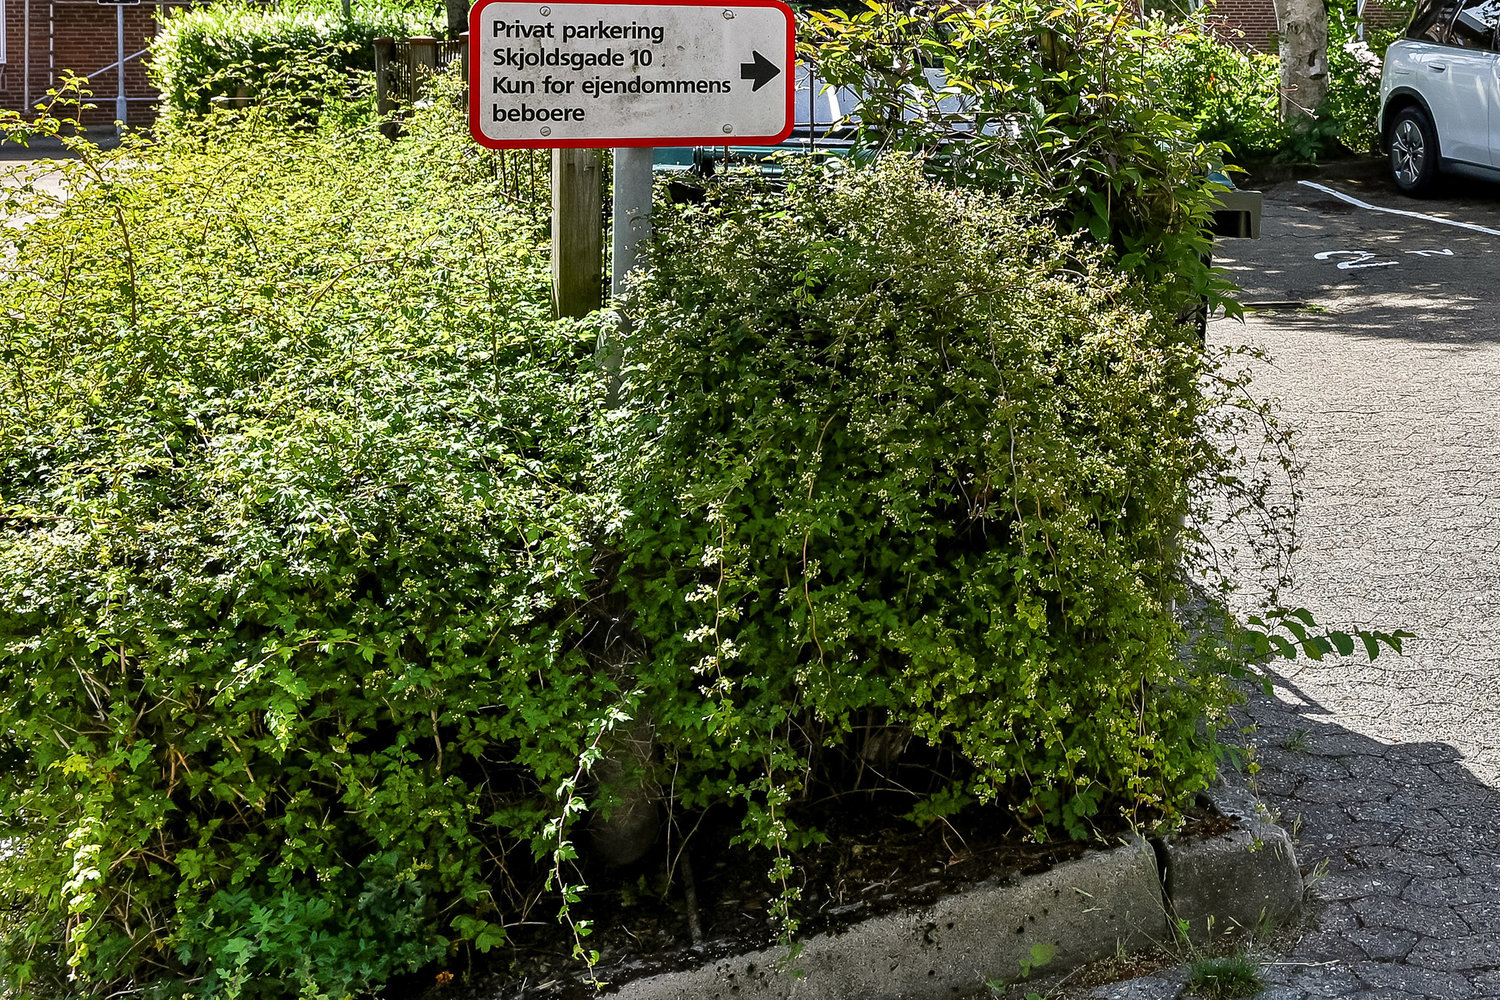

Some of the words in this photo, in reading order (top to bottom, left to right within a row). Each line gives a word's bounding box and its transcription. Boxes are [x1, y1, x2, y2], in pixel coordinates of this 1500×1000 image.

[492, 20, 555, 39] Privat
[562, 20, 665, 43] parkering
[492, 47, 625, 71] Skjoldsgade
[629, 49, 653, 67] 10
[492, 76, 535, 94] Kun
[541, 75, 575, 94] for
[581, 75, 731, 99] ejendommens
[492, 103, 586, 122] beboere
